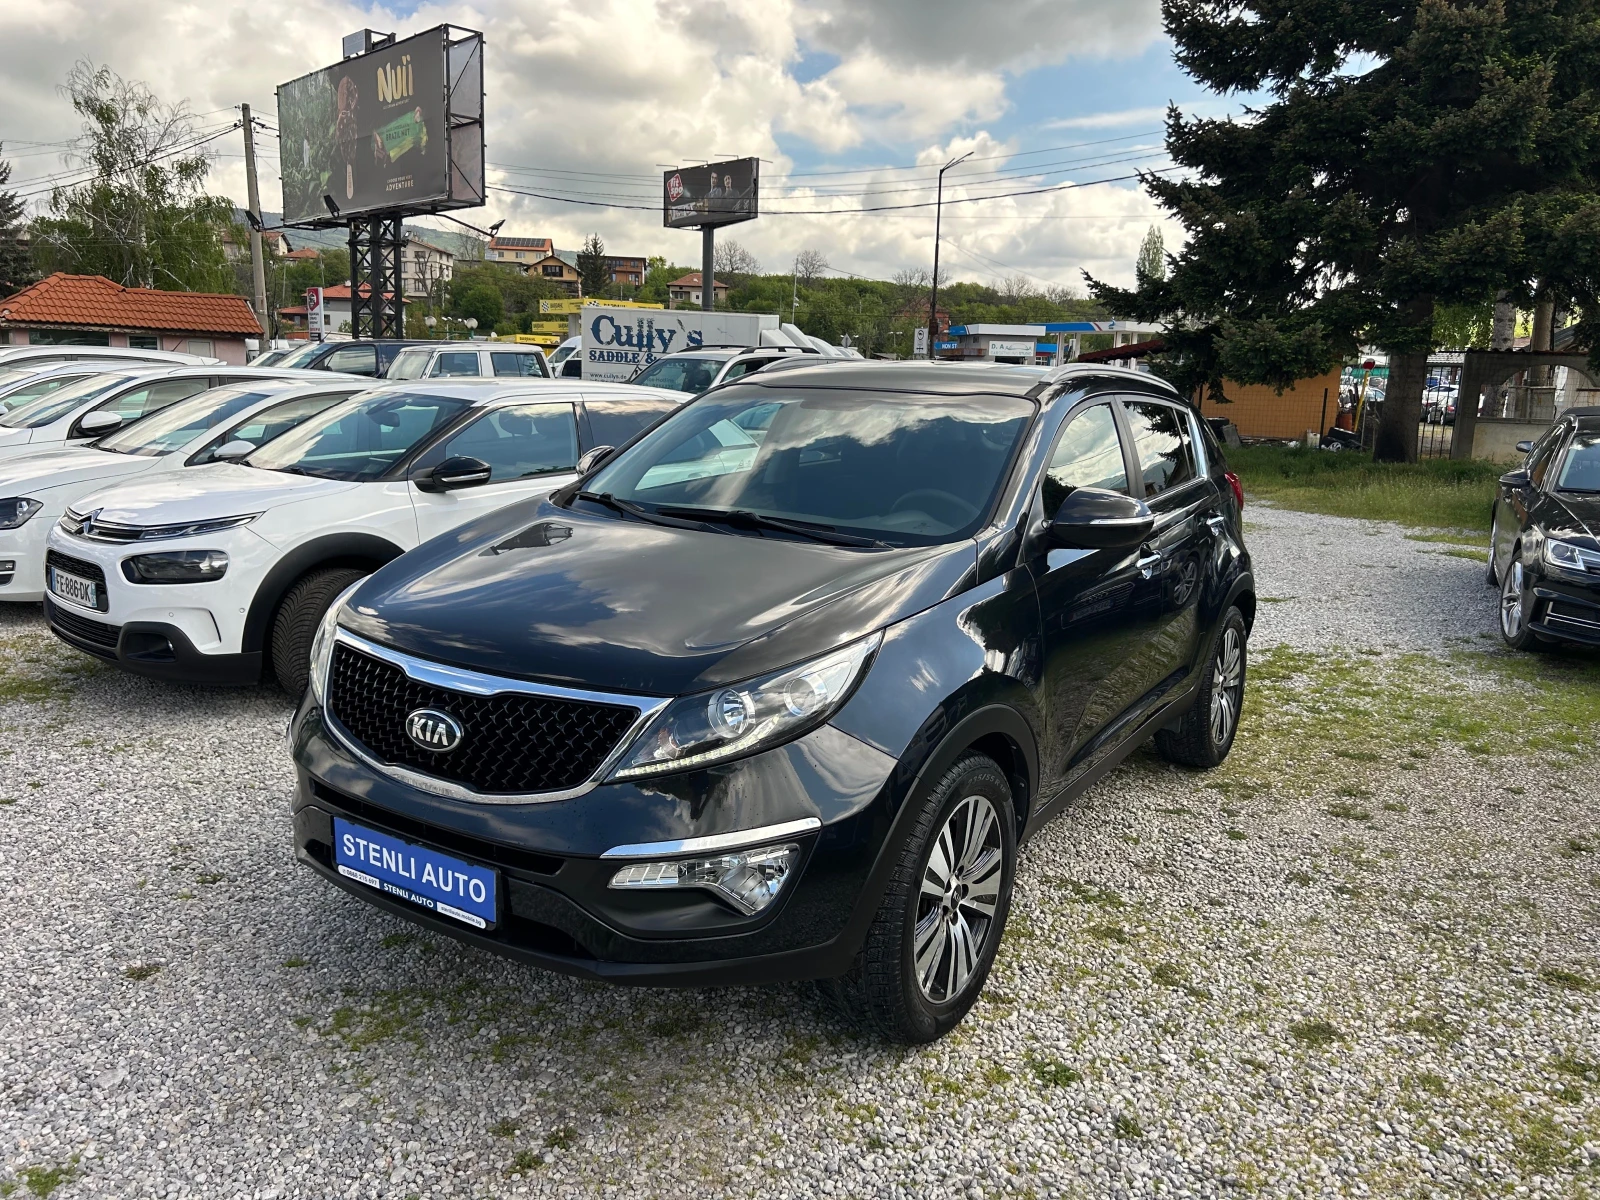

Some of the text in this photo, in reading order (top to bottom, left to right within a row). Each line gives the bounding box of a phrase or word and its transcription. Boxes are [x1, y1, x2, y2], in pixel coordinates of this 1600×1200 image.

[386, 128, 410, 142] BRAZIL NUT
[386, 179, 414, 191] ADVENTURE
[589, 350, 640, 363] SADDLE
[411, 716, 449, 746] KIA
[343, 833, 486, 903] STENLI AUTO
[383, 882, 434, 908] STENLI AUTO
